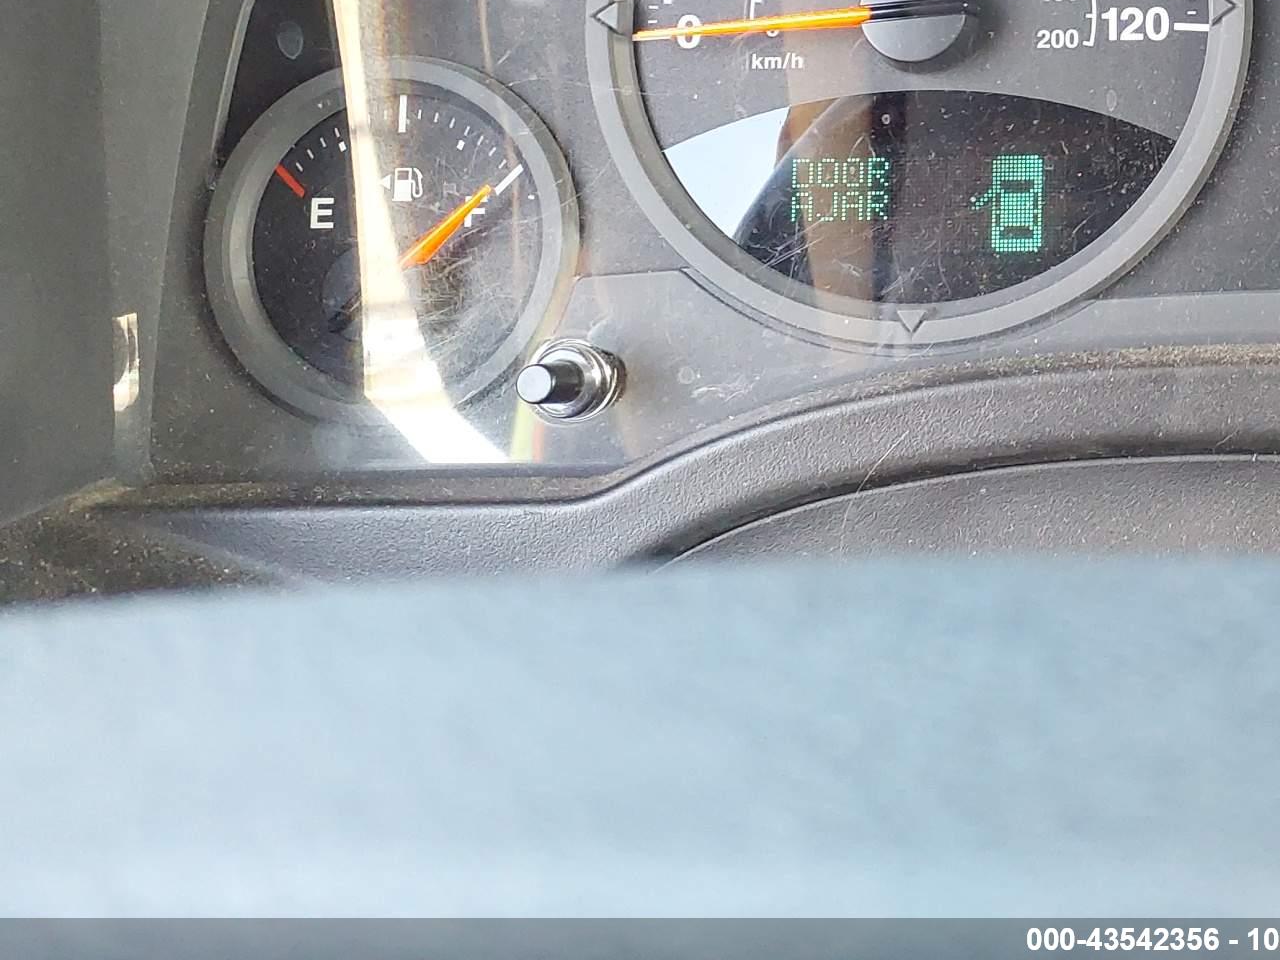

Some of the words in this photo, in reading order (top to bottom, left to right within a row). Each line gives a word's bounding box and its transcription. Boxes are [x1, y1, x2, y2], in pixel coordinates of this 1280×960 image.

[676, 14, 701, 49] 0
[1036, 29, 1080, 49] 200
[1102, 7, 1170, 41] 120
[751, 51, 804, 72] km/h
[791, 157, 889, 188] DOOR
[310, 197, 335, 229] E
[790, 190, 889, 222] AJAR
